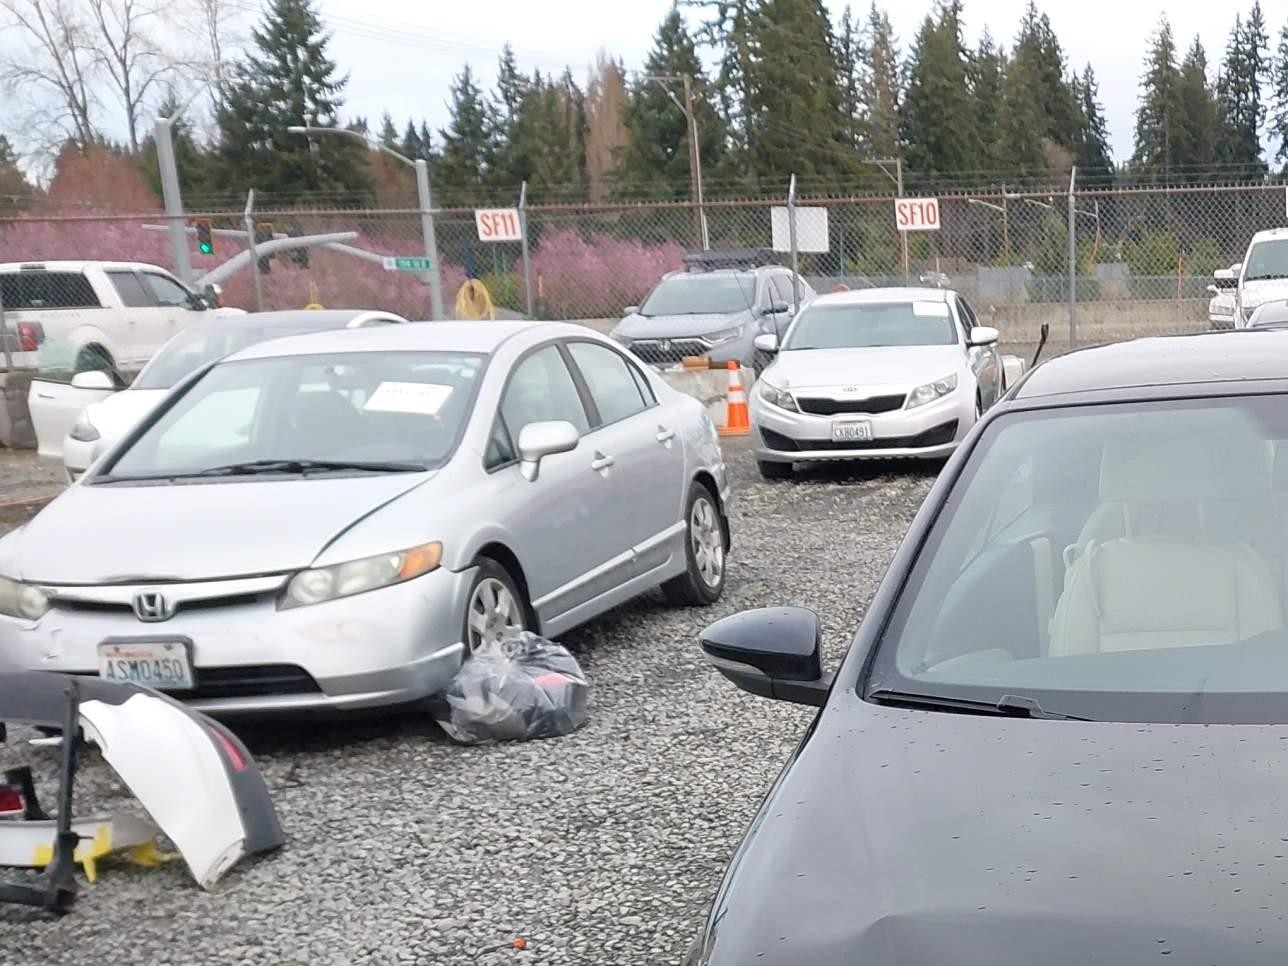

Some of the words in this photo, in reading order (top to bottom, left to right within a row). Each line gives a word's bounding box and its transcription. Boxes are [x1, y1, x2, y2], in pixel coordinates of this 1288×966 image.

[480, 213, 516, 236] SF11
[898, 203, 937, 225] SF10
[107, 659, 184, 681] ASM0450
